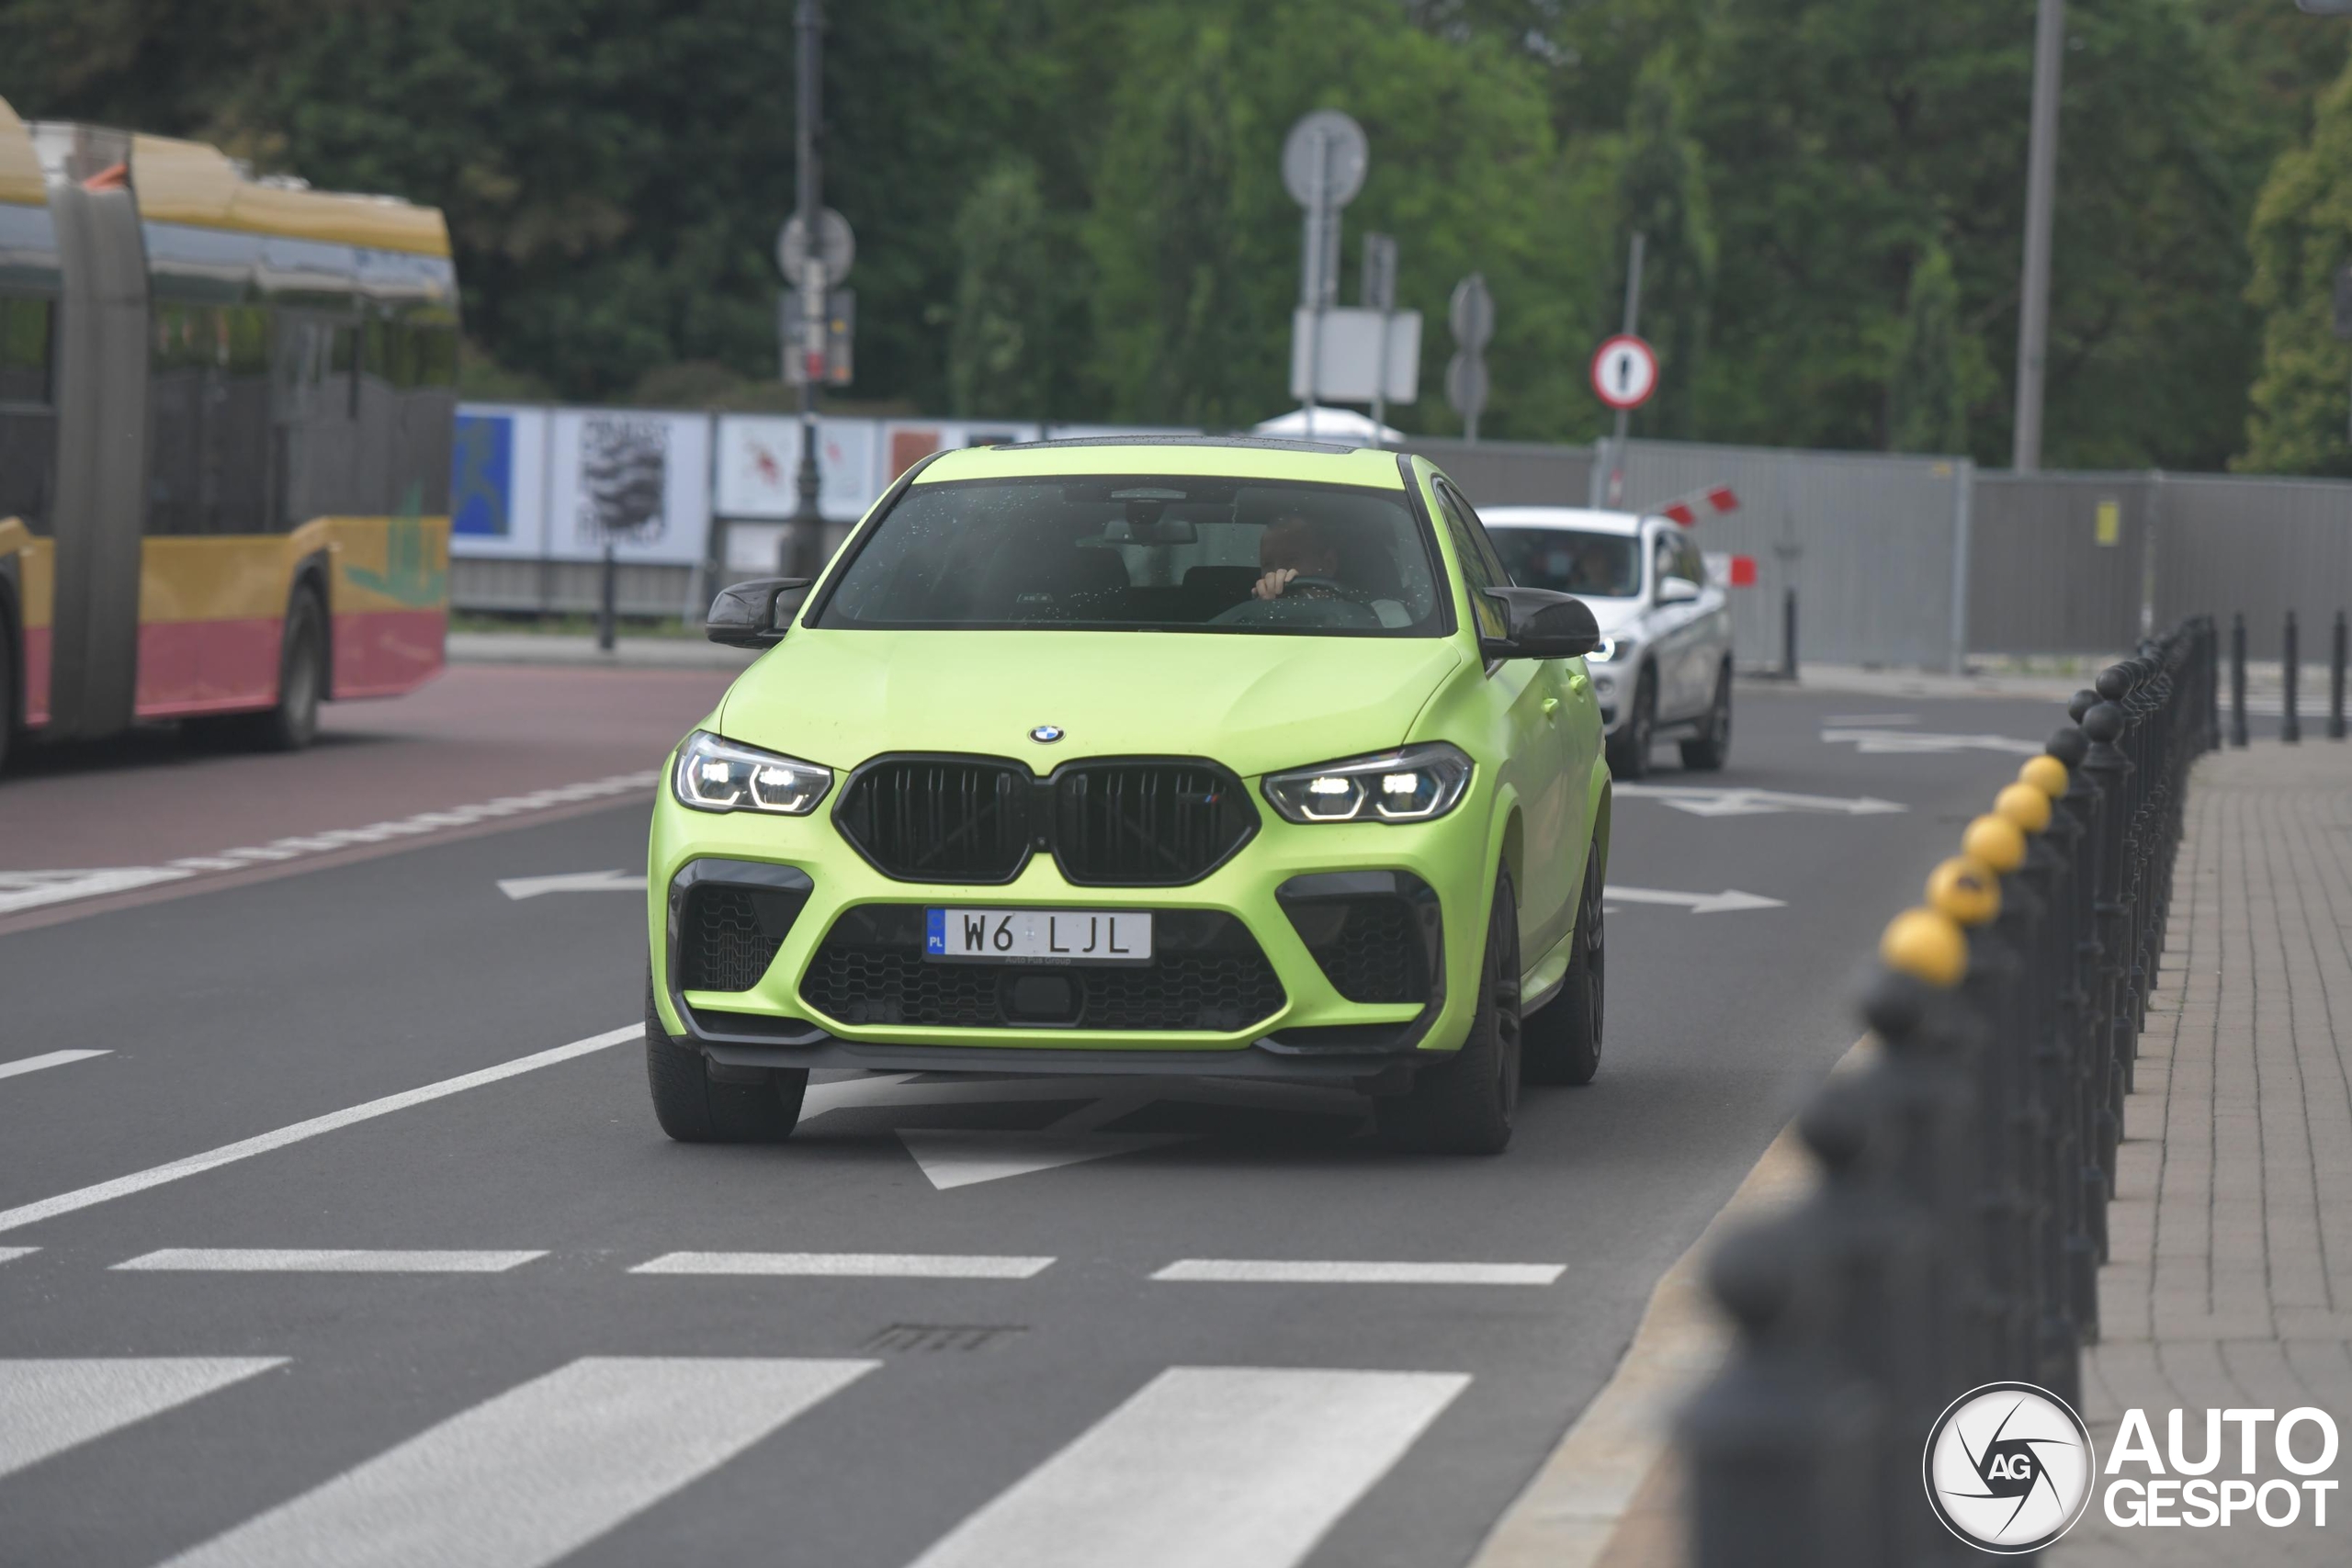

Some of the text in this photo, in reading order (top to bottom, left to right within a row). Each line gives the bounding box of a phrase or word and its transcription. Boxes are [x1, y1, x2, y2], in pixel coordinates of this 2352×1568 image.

[964, 914, 1130, 953] W6 LJL
[929, 936, 943, 947] PL
[1005, 955, 1025, 964] Auto
[1045, 956, 1071, 966] Group
